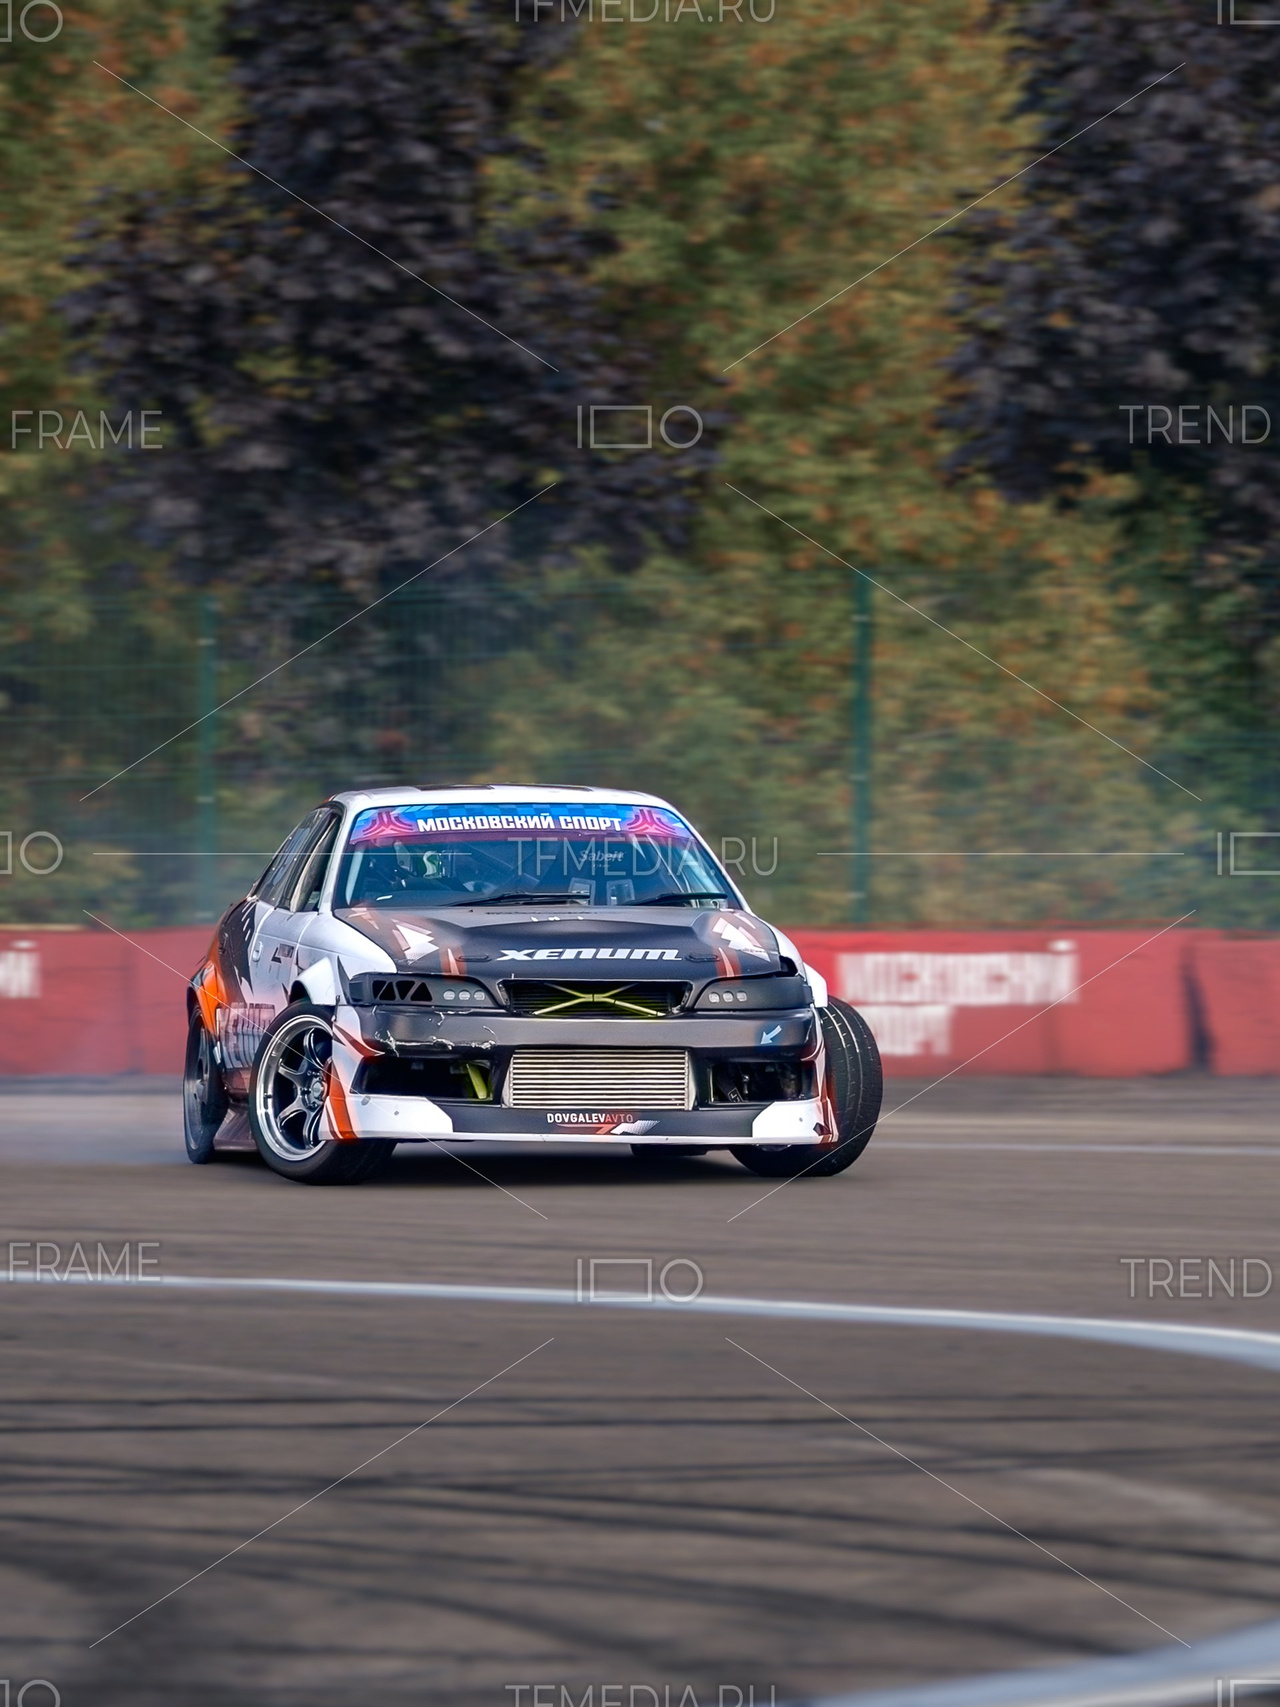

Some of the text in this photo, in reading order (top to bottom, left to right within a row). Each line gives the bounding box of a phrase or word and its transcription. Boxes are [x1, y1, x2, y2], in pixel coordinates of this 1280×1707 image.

[417, 812, 622, 832] МОСКОВСКИЙ СПОРТ
[497, 948, 682, 961] XENUM
[546, 1113, 634, 1124] DOVGALEVAVTO
